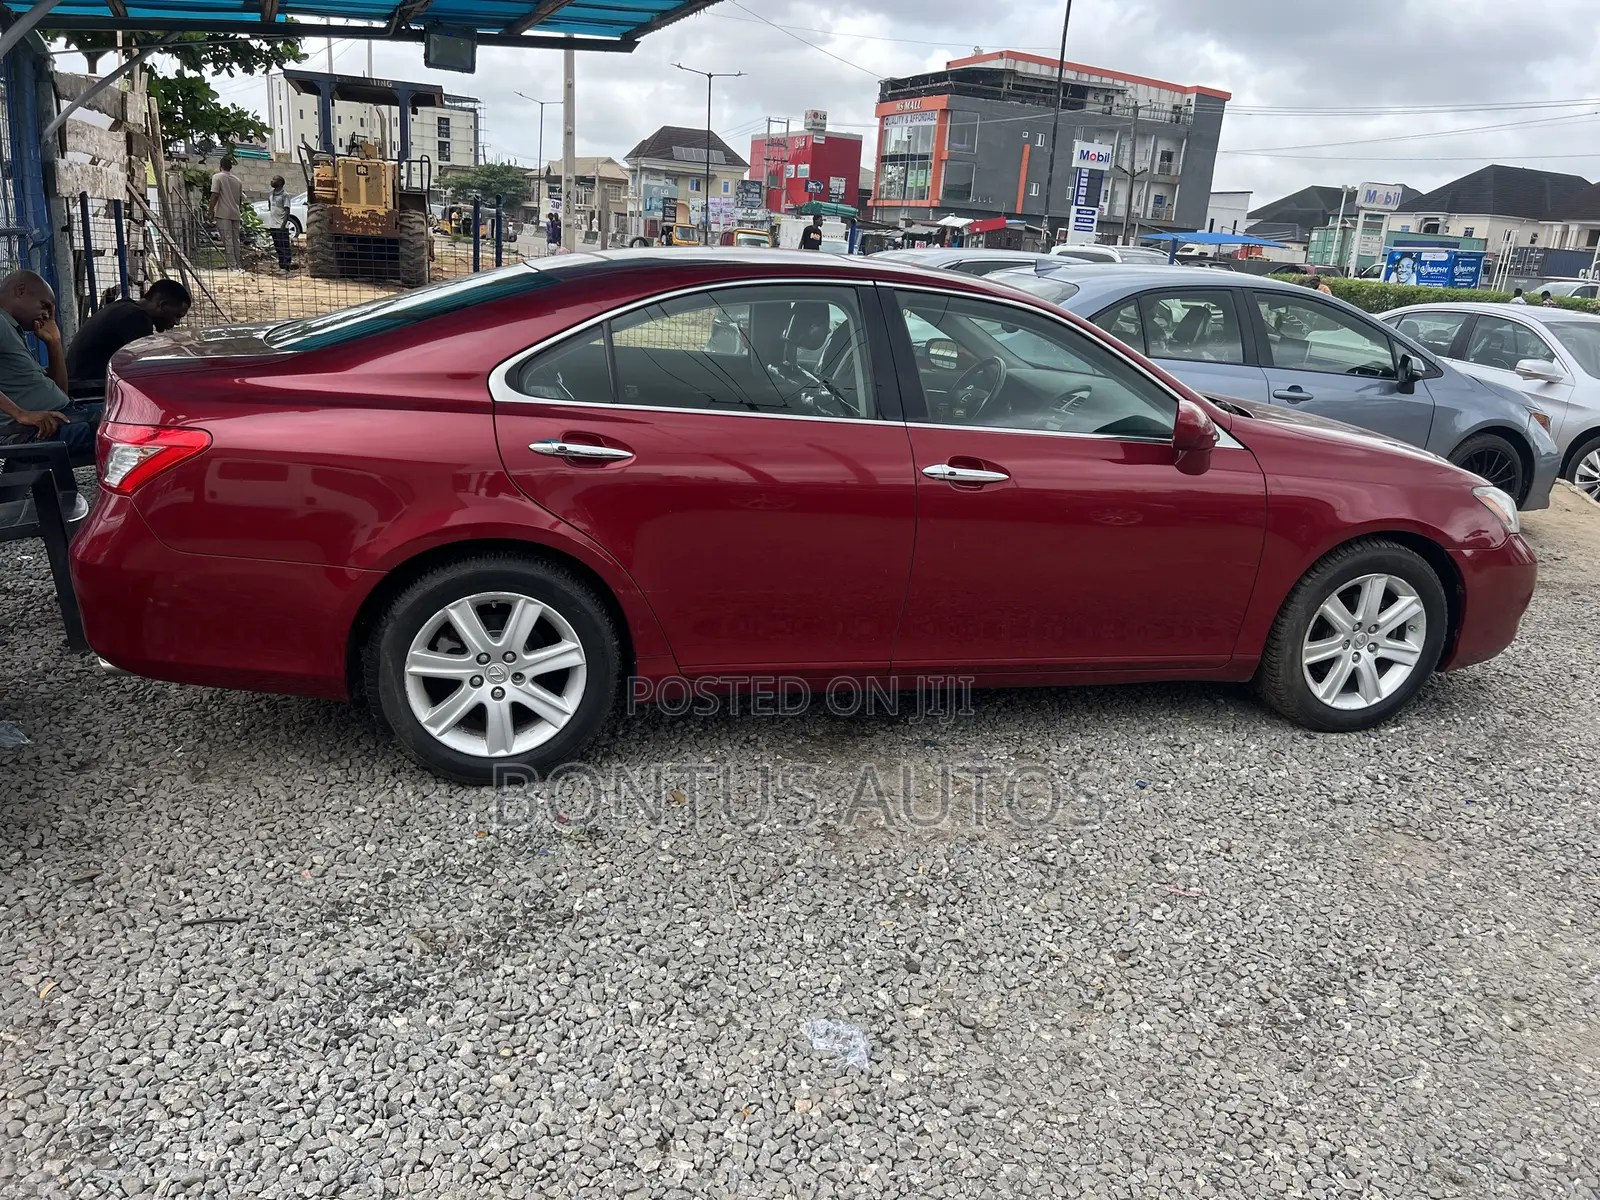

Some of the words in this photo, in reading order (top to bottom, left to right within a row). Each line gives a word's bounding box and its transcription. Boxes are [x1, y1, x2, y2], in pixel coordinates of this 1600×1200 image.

[905, 100, 922, 110] MALL
[1080, 149, 1110, 163] Mobil
[1364, 189, 1400, 206] Mobil
